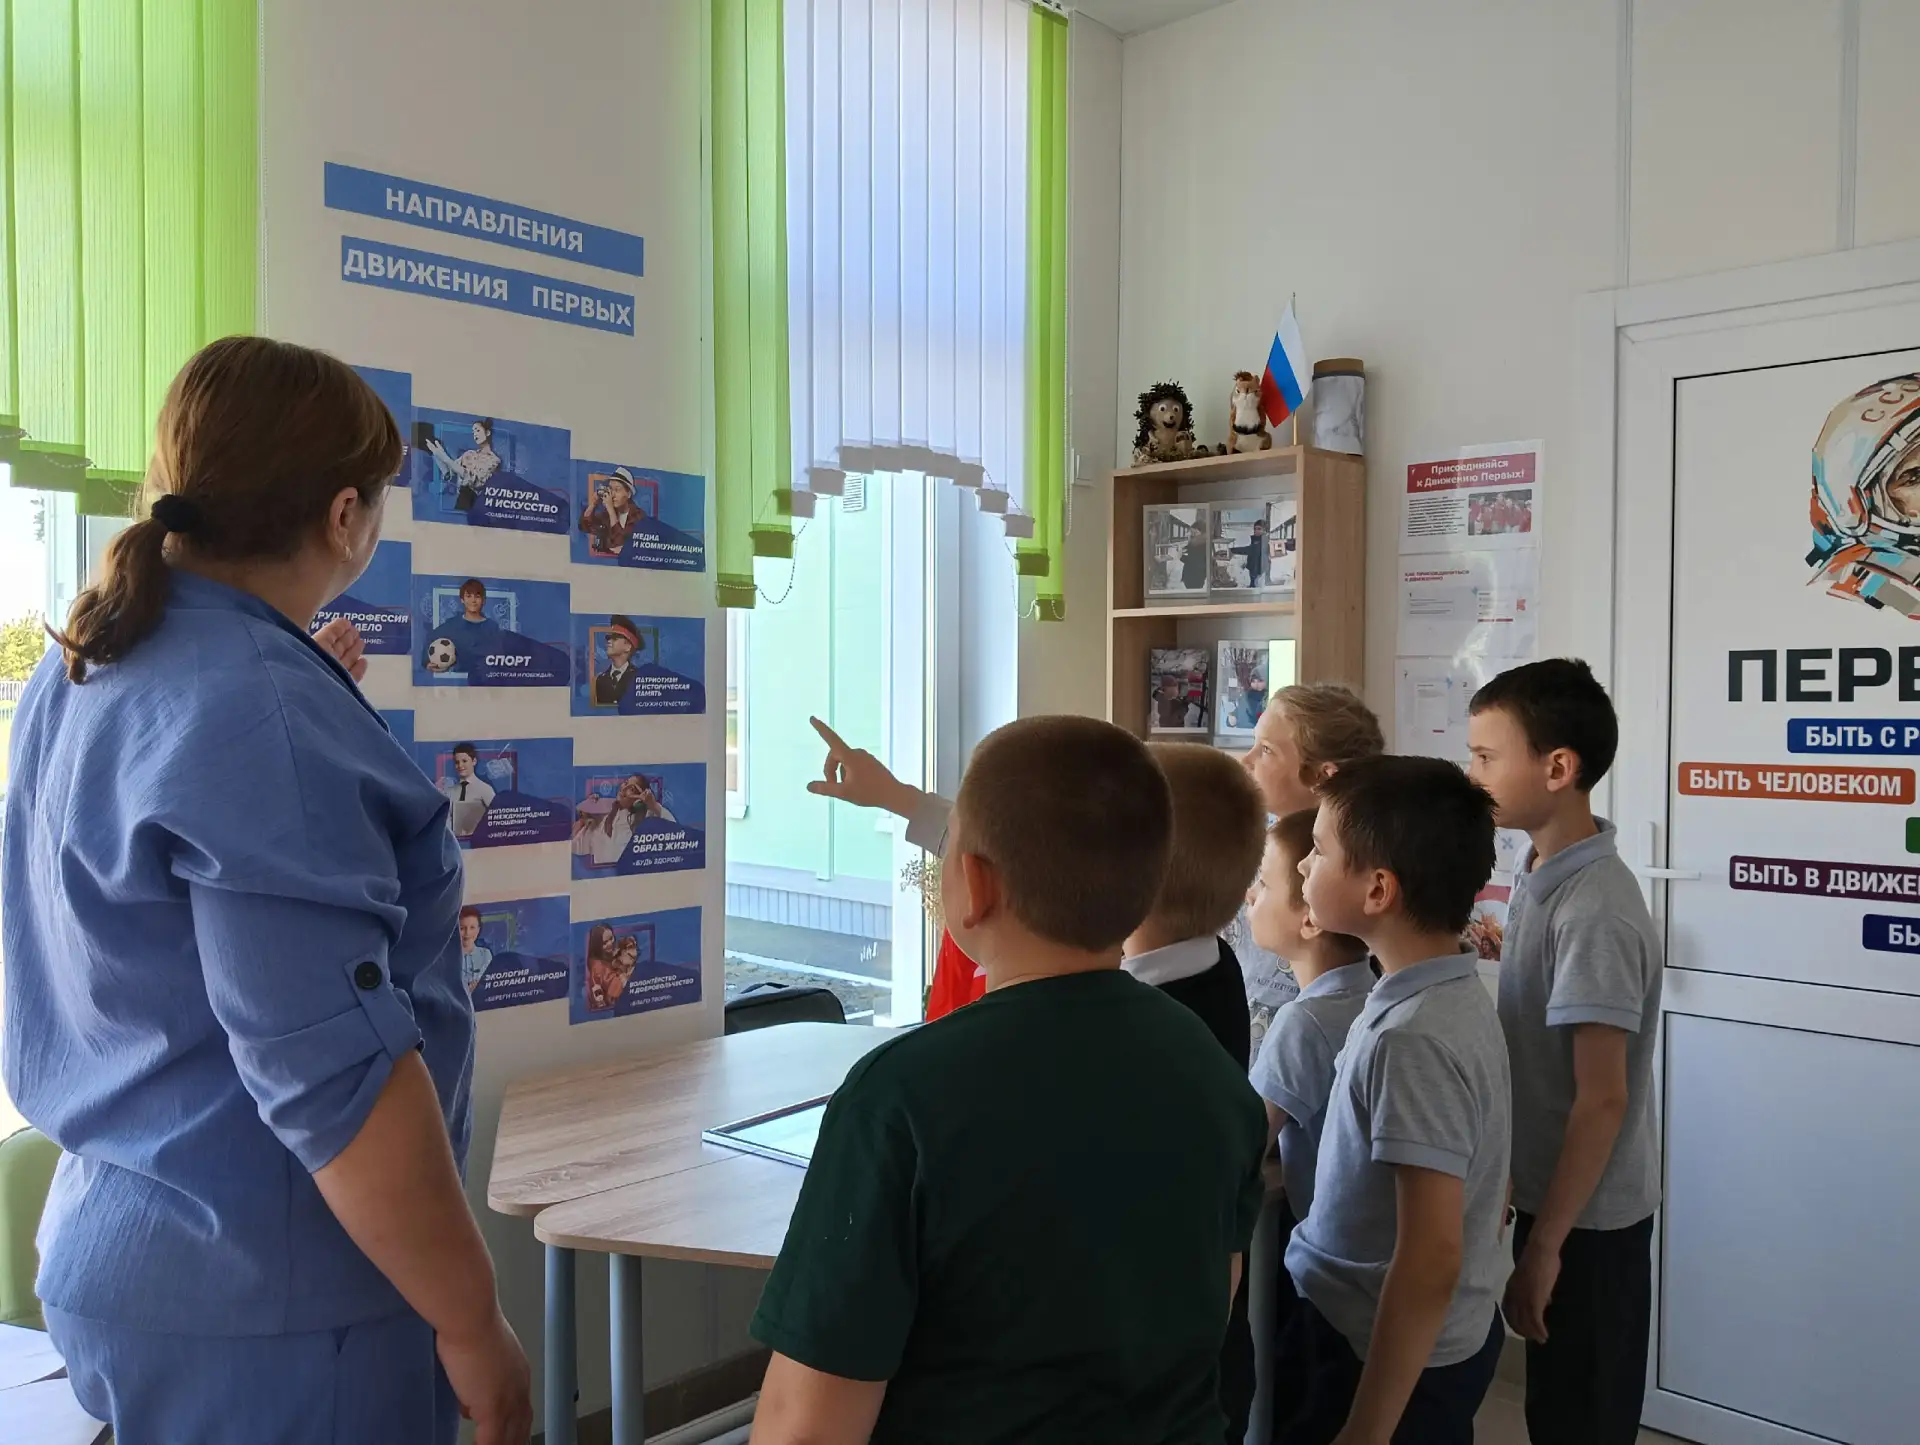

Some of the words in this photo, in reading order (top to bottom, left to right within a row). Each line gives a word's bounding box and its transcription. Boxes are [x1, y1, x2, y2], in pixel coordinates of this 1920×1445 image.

[386, 187, 583, 253] НАПРАВЛЕНИЯ
[344, 248, 508, 302] ДВИЖЕНИЯ
[532, 285, 632, 328] ПЕРВЫХ
[1431, 460, 1509, 474] Присоединяйся
[1424, 475, 1479, 488] Движению
[1481, 469, 1525, 483] Первых!
[484, 487, 540, 501] КУЛЬТУРА
[485, 498, 493, 507] И
[495, 499, 559, 514] ИСКУССТВО
[632, 533, 660, 541] МЕДИА
[640, 542, 703, 554] КОММУНИКАЦИИ
[313, 611, 340, 620] РУД
[343, 613, 408, 623] ПРОФЕССИЯ
[311, 621, 319, 630] И
[485, 654, 532, 667] СПОРТ
[1806, 726, 1873, 747] БЫТЬ
[1880, 727, 1896, 748] С
[1689, 769, 1751, 791] БЫТЬ
[1757, 771, 1902, 797] ЧЕЛОВЕКОМ
[633, 830, 685, 844] ЗДОРОВЫЙ
[633, 843, 664, 853] ОБРАЗ
[665, 840, 699, 850] ЖИЗНИ
[1734, 862, 1798, 886] БЫТЬ
[1805, 867, 1820, 888] В
[1826, 869, 1920, 895] ДВИЖЕ
[485, 969, 530, 981] ЭКОЛОГИЯ
[493, 977, 526, 988] ОХРАНА
[528, 971, 567, 983] ПРИРОДЫ
